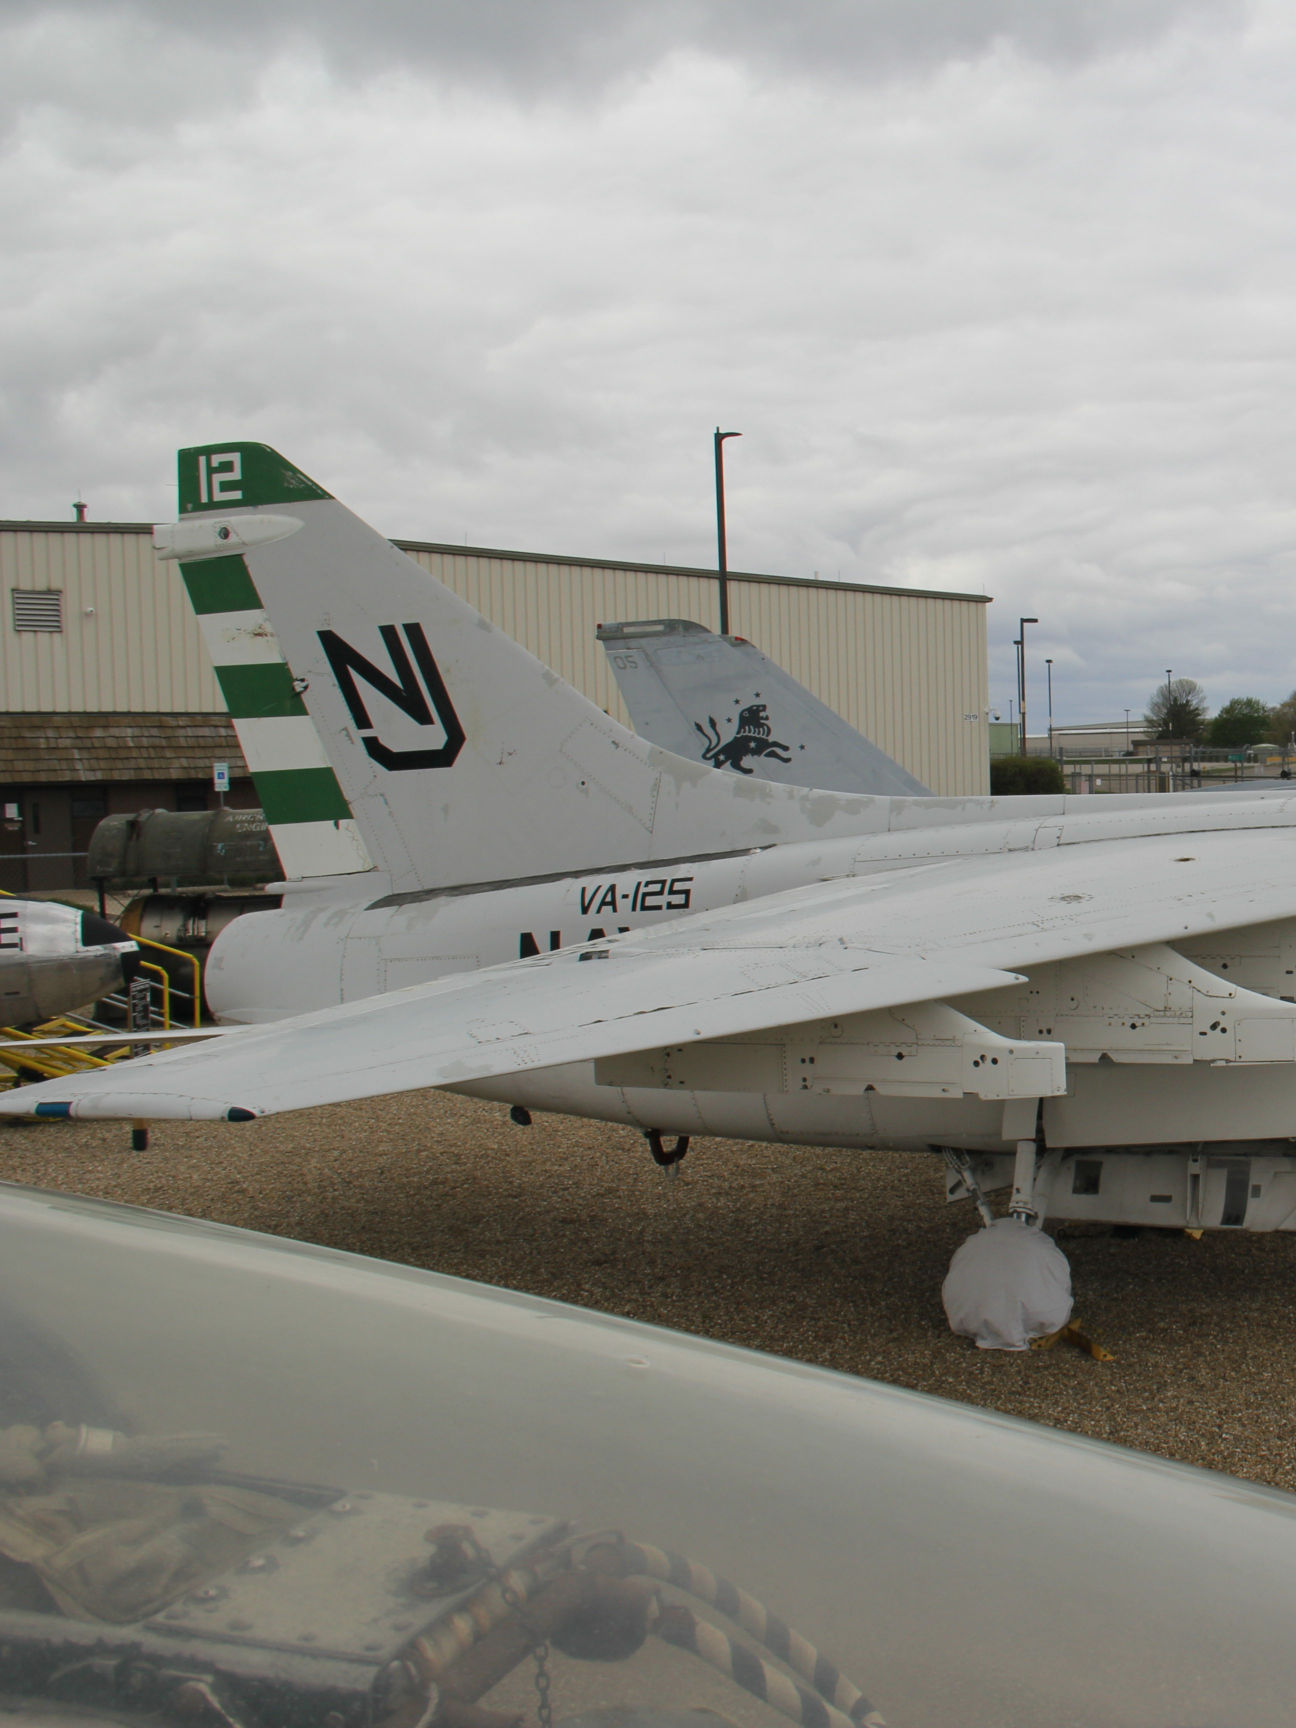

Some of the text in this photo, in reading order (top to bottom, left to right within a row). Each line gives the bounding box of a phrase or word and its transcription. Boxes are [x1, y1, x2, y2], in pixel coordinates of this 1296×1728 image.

[198, 451, 243, 503] 12
[315, 621, 466, 772] NJ
[581, 876, 694, 916] VA-125
